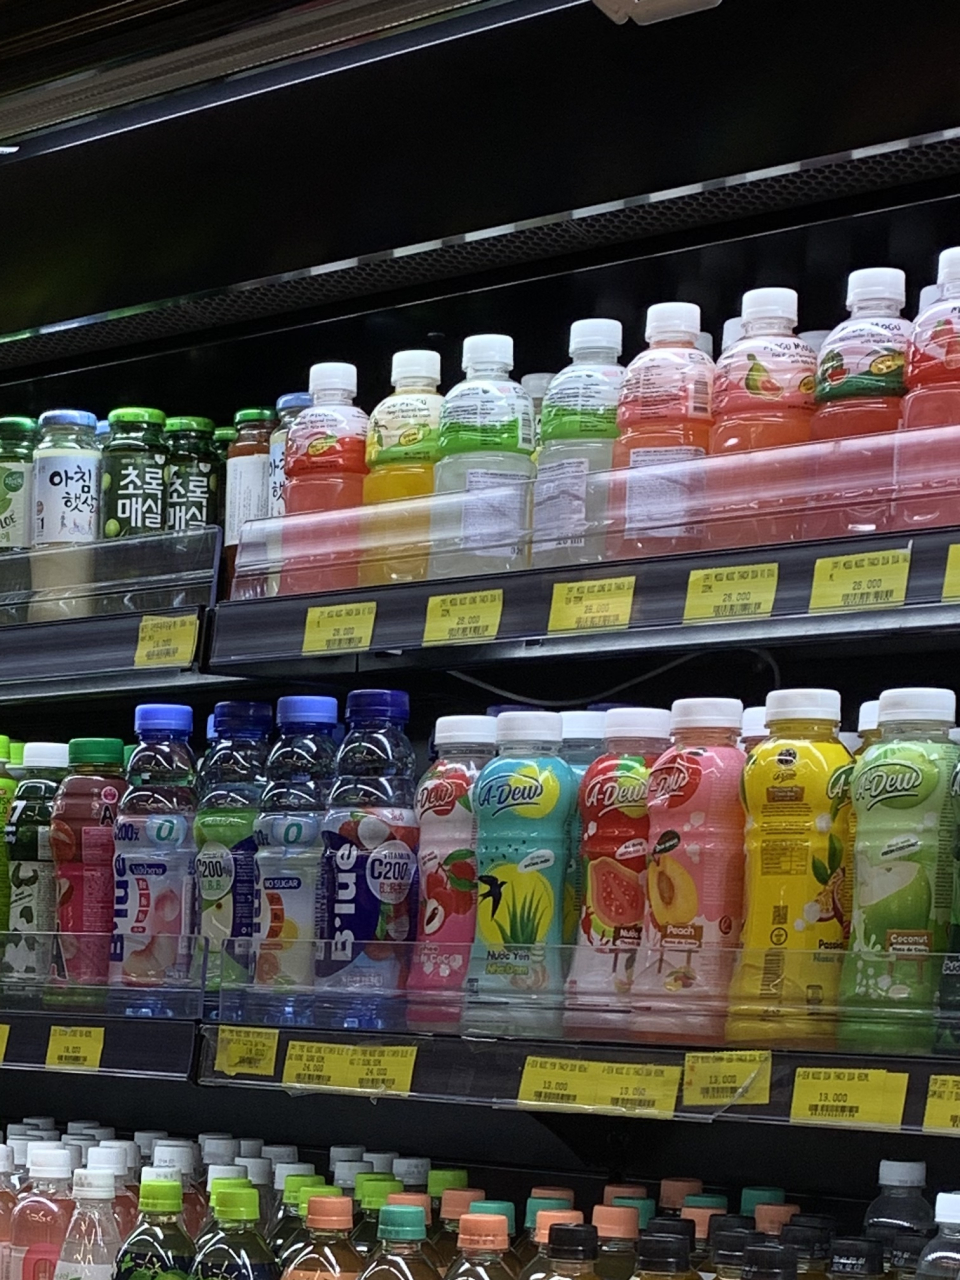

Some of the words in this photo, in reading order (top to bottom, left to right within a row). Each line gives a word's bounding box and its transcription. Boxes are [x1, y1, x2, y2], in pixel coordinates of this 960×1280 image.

[48, 466, 93, 494] 아침
[117, 466, 165, 497] 초록
[169, 473, 210, 506] 초록
[62, 492, 97, 514] 햇살
[117, 497, 163, 529] 매실
[478, 776, 542, 810] A-Dew
[586, 777, 647, 808] A-Dew
[856, 765, 922, 803] A-Dew
[275, 878, 299, 889] SUGAR
[667, 925, 694, 936] Peach
[819, 939, 843, 950] Passio
[891, 934, 928, 944] Coconut
[819, 1093, 848, 1103] 13.000
